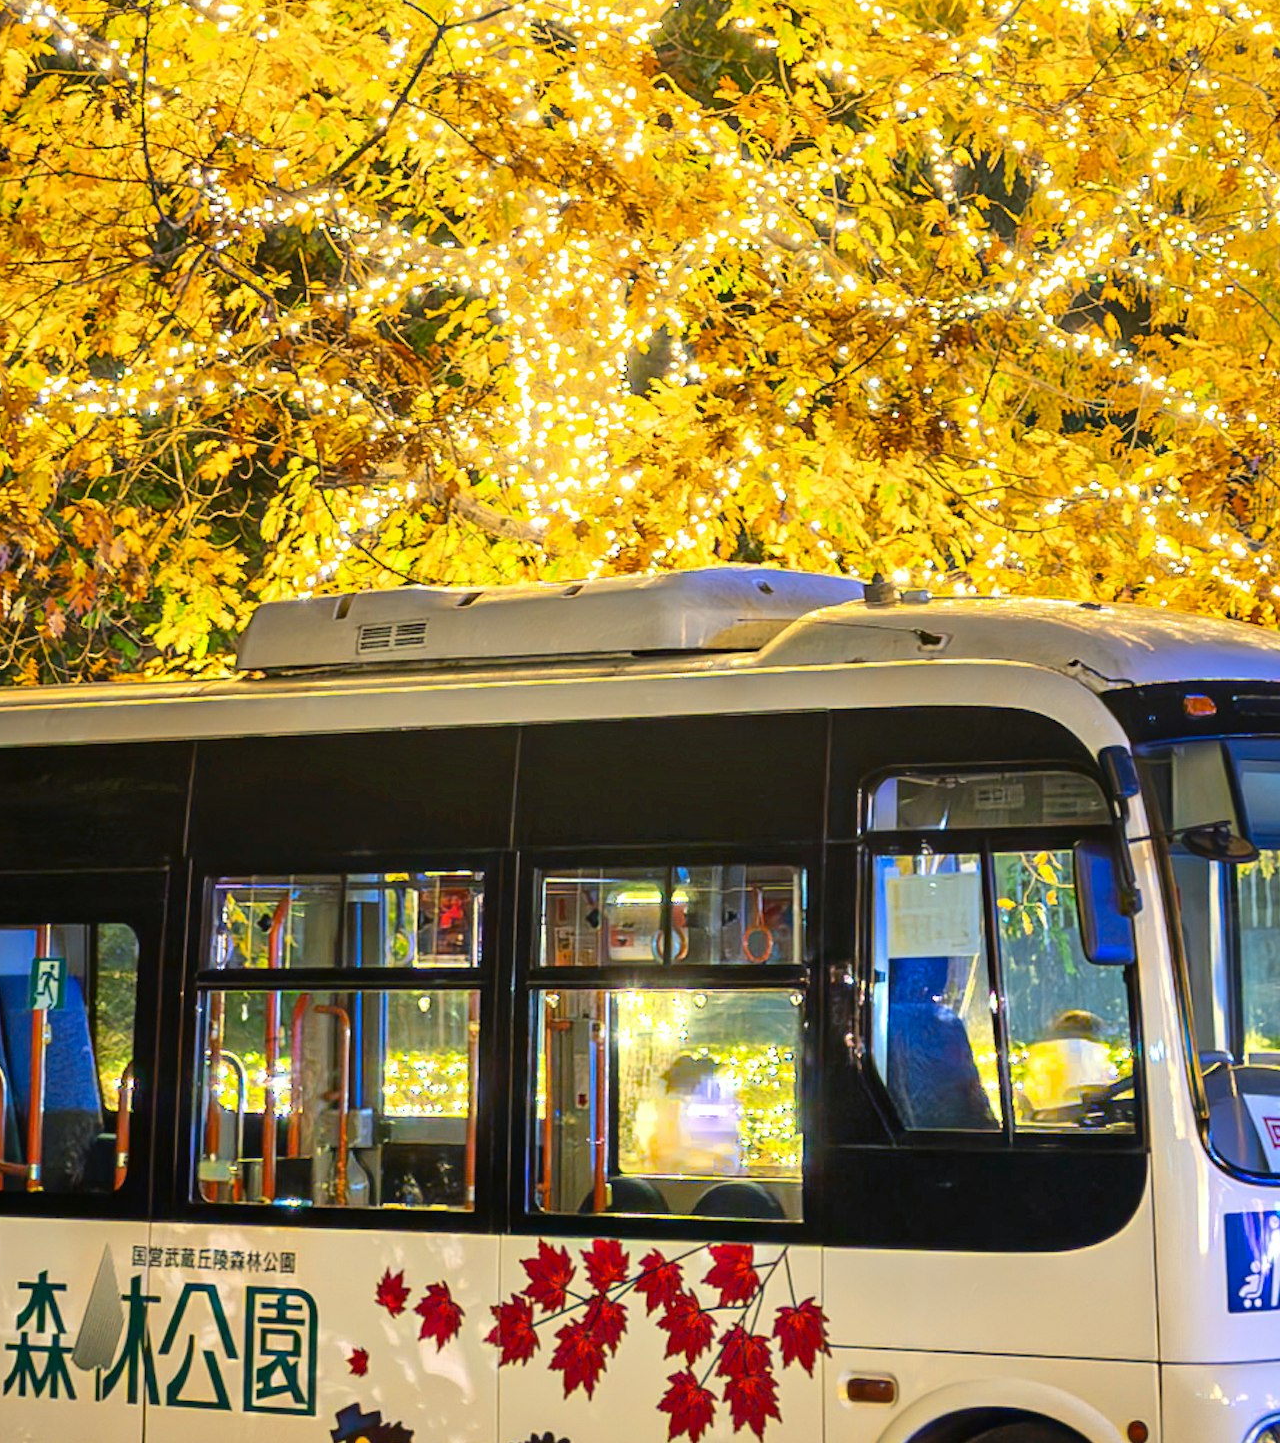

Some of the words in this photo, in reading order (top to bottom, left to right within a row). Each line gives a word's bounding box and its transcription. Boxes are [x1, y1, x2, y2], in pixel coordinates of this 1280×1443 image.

[132, 1245, 296, 1274] 国営武蔵丘陵森林公園
[3, 1267, 318, 1417] 森林公園
